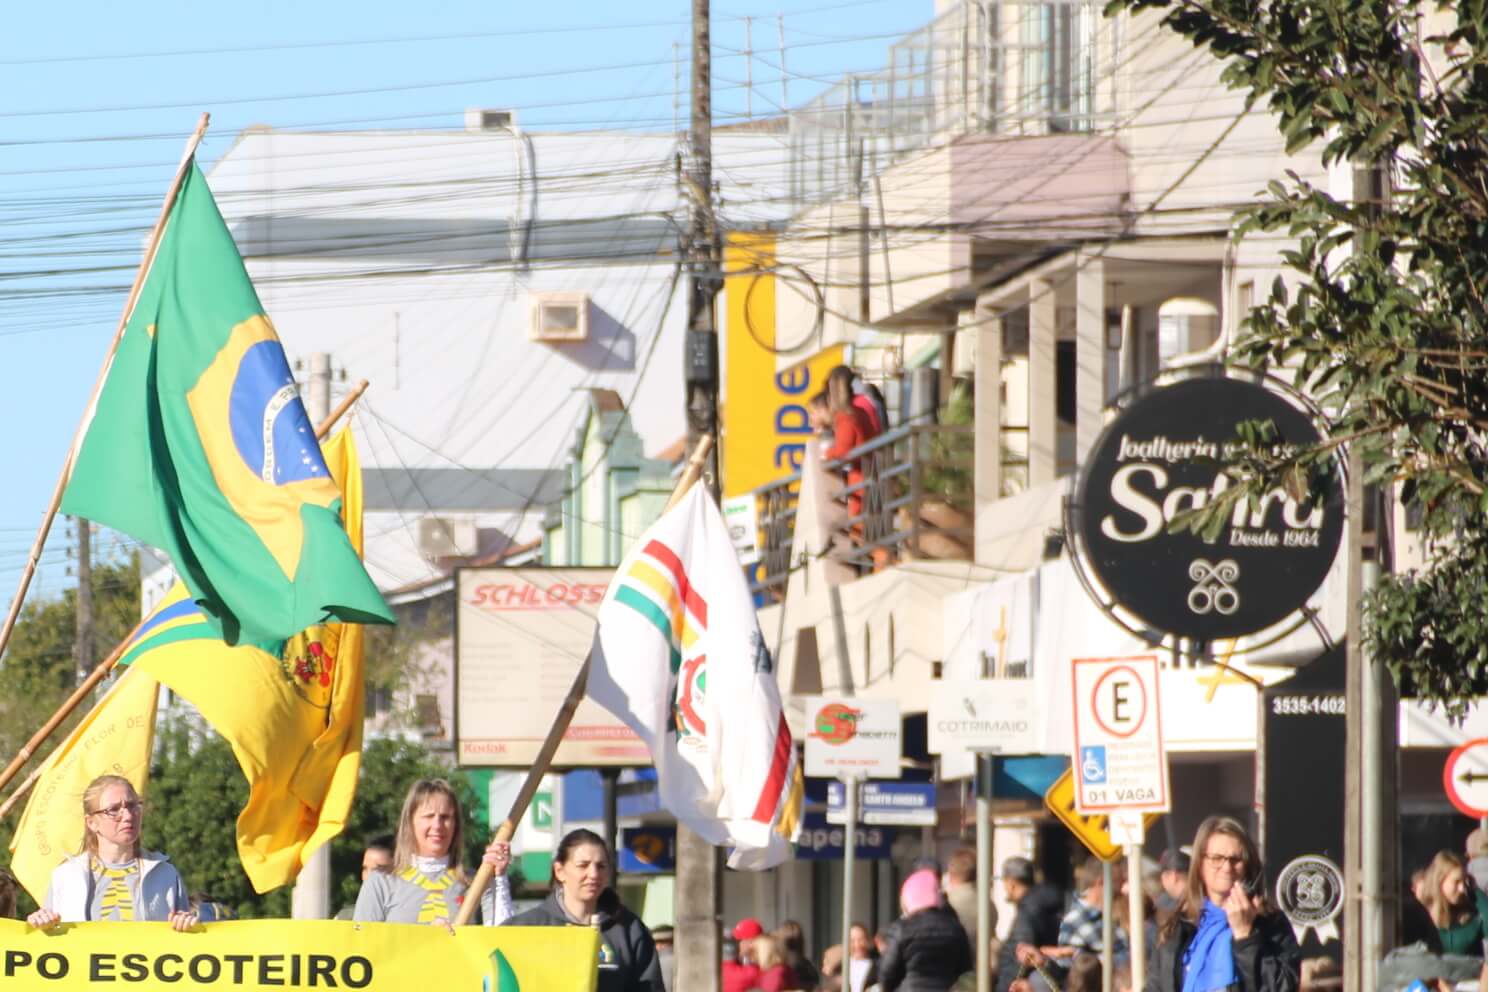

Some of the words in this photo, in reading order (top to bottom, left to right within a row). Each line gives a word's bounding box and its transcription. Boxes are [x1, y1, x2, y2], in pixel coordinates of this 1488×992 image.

[1229, 529, 1279, 546] Desde
[1282, 529, 1320, 547] 1964
[1112, 681, 1131, 723] E
[937, 720, 1029, 734] COTRIMAIO
[1089, 791, 1107, 803] 01
[1115, 788, 1156, 802] VAGA
[89, 953, 373, 989] ESCOTEIRO
